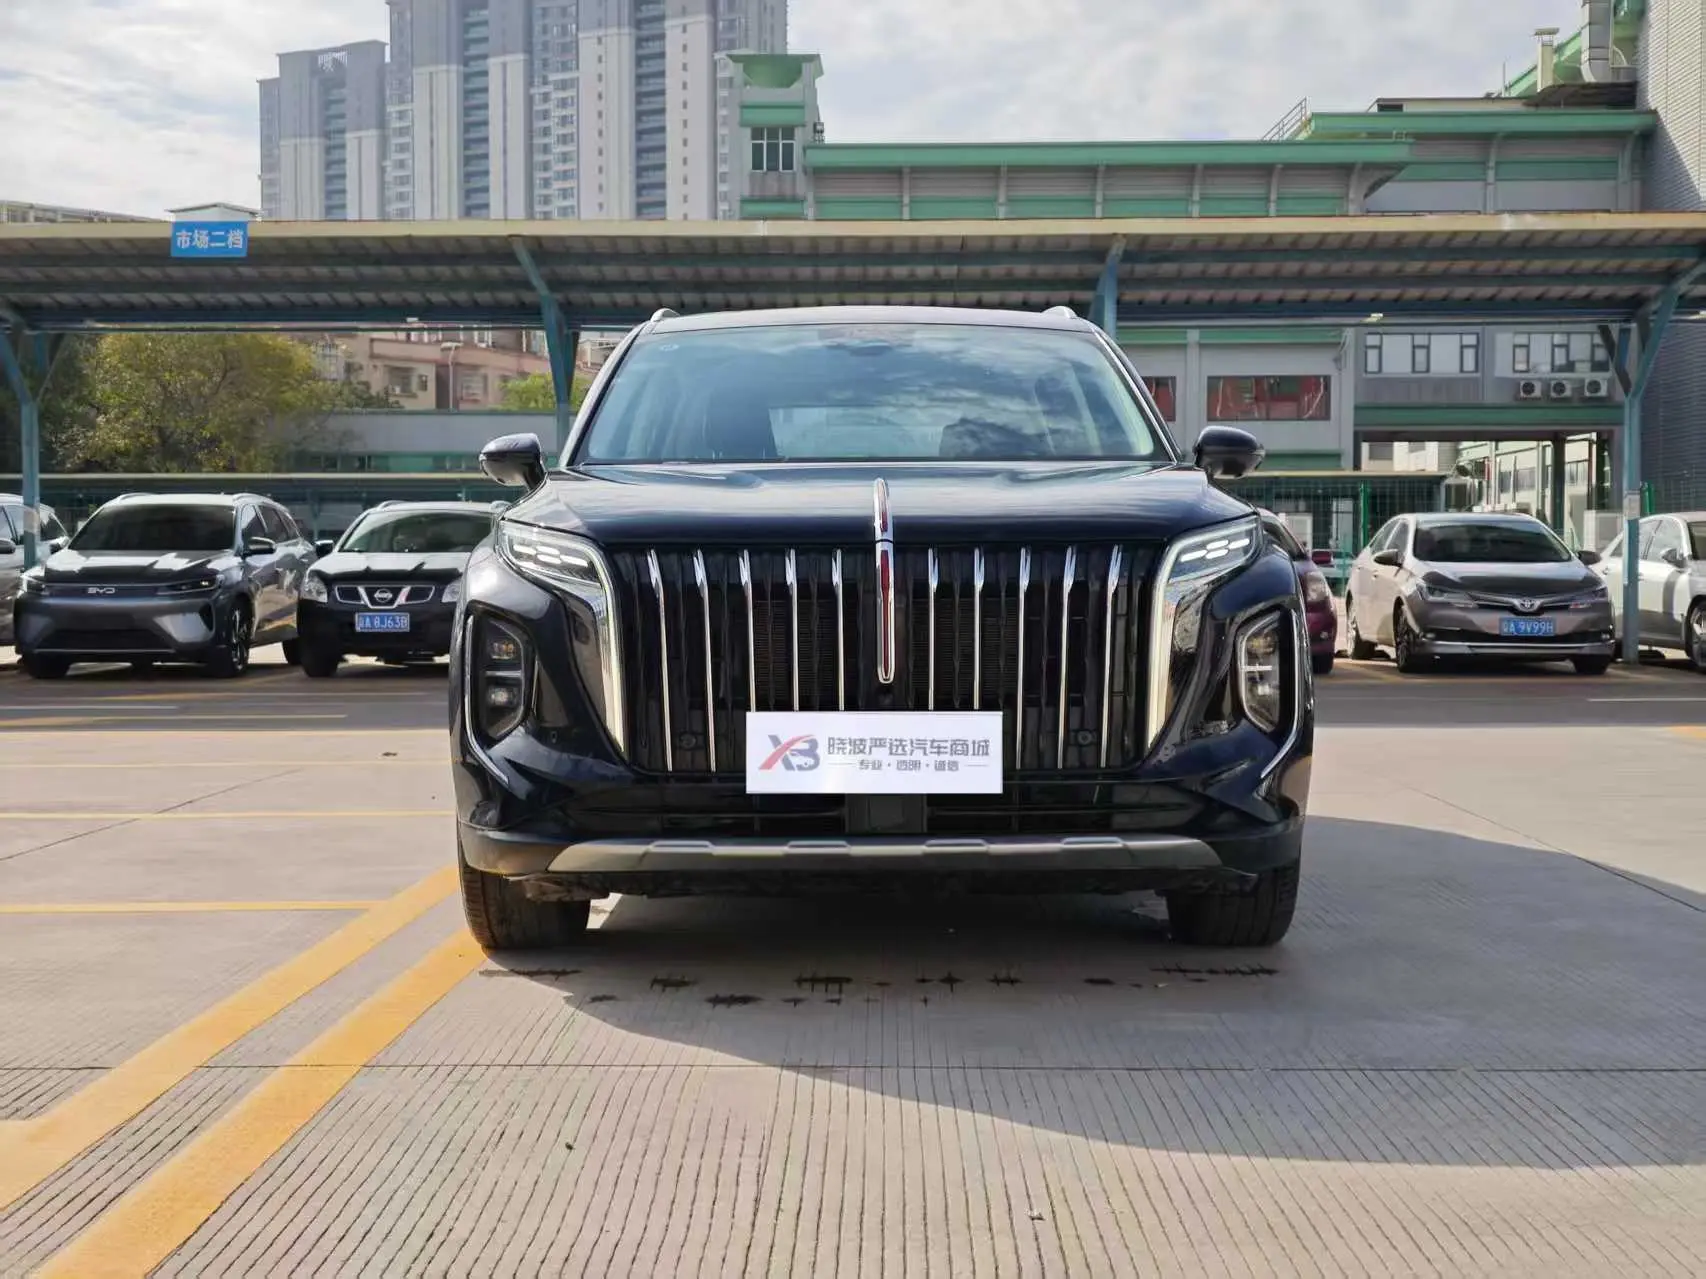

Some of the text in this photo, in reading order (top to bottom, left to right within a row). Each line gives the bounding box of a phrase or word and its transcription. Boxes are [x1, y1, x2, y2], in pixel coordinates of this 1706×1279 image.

[175, 228, 243, 250] 市场二档
[827, 737, 989, 757] 晓波严选汽车商城
